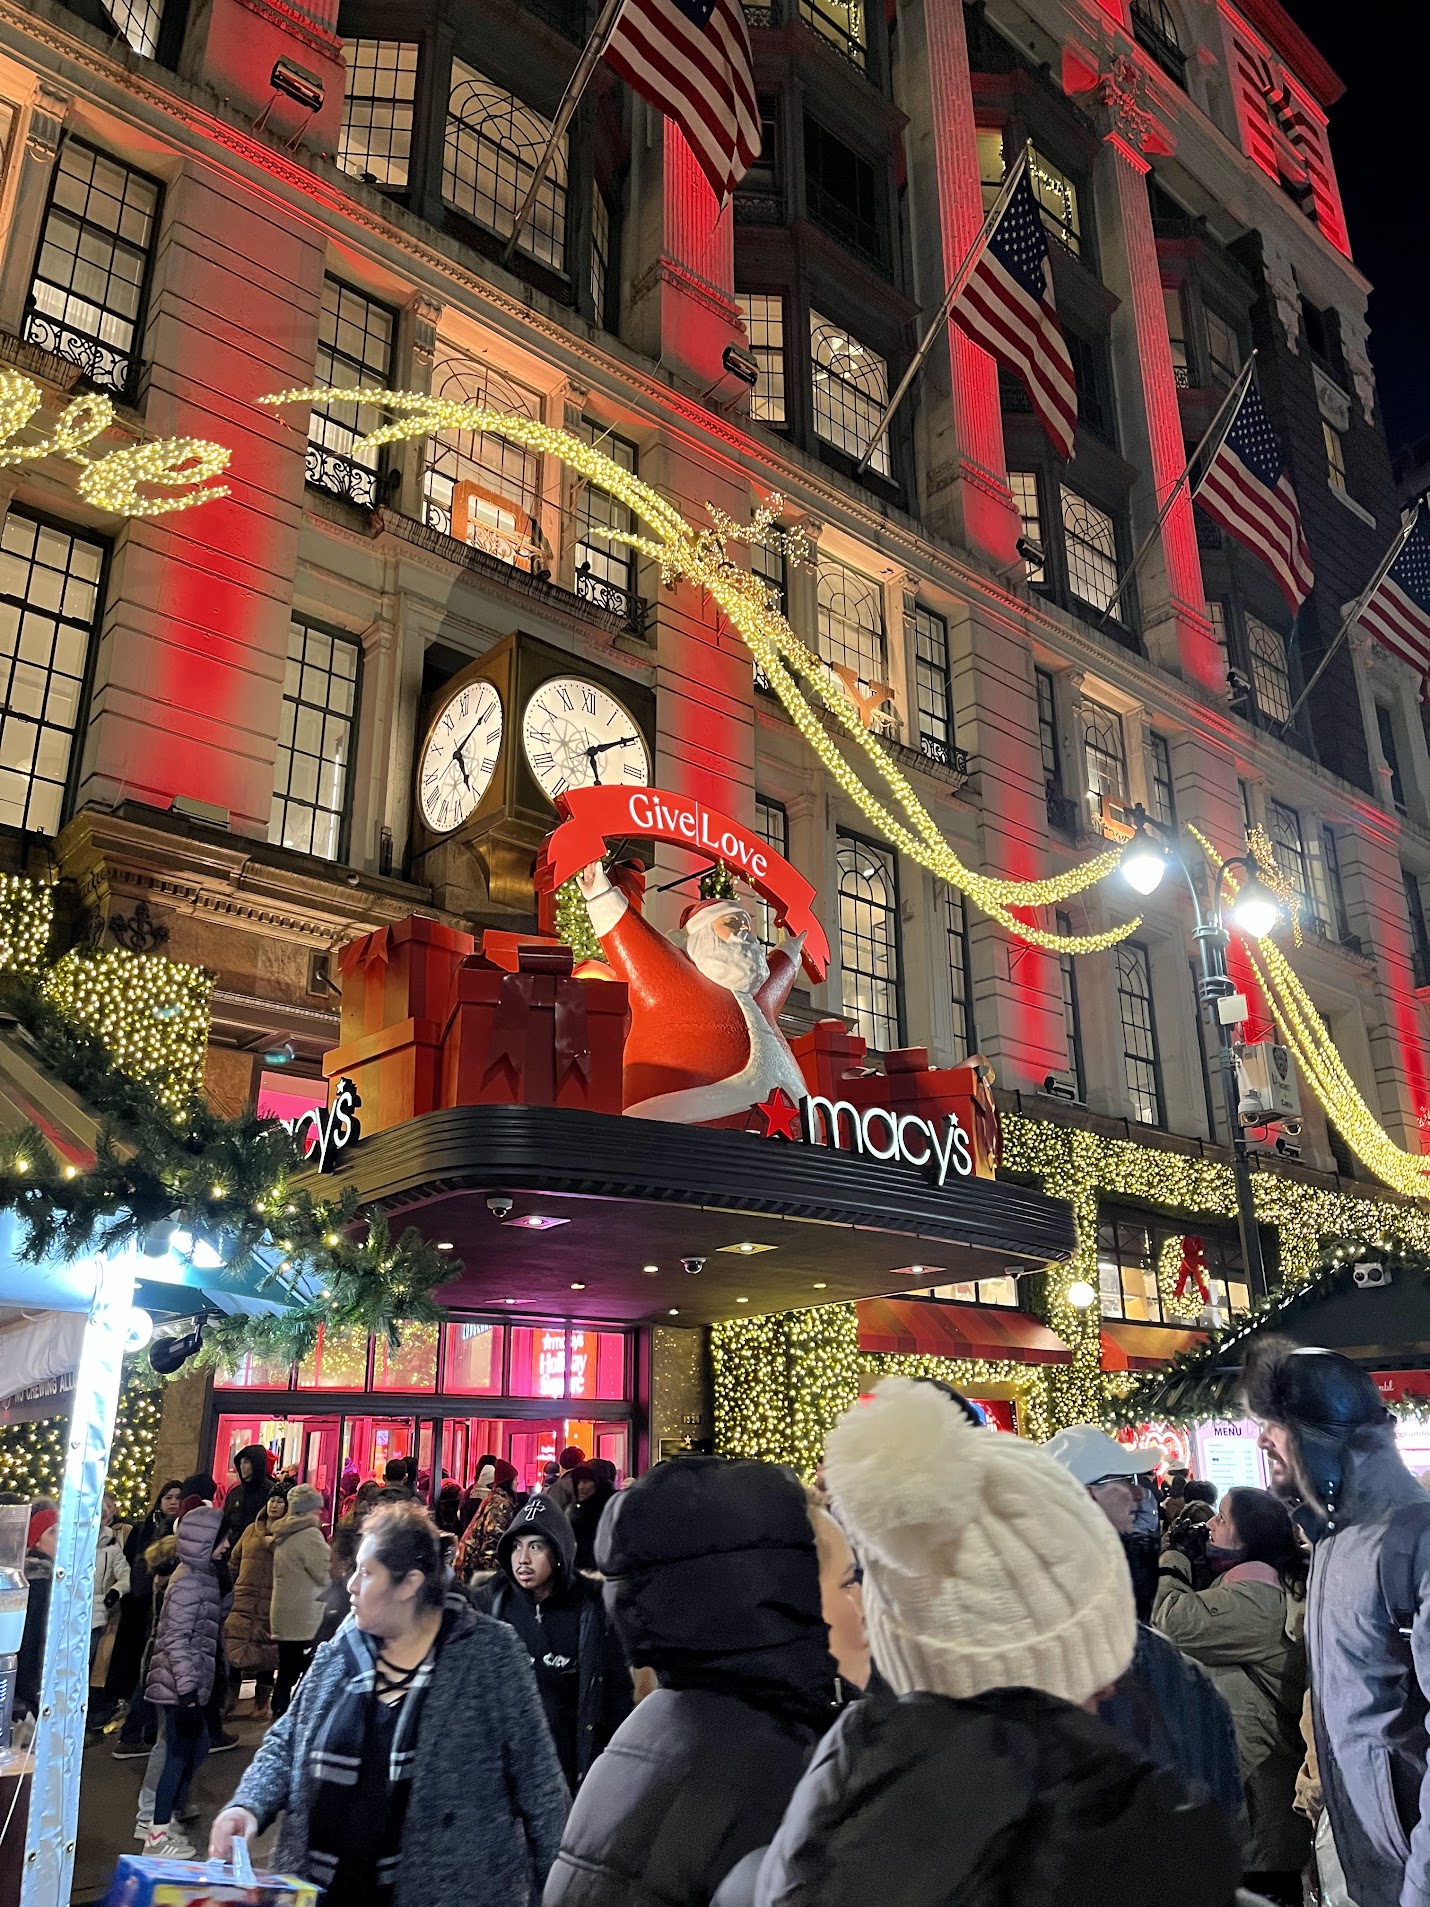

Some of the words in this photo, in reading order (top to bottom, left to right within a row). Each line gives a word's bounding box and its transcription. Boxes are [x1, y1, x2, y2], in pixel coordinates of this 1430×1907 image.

[537, 699, 558, 723] X
[581, 689, 596, 716] XII
[623, 763, 642, 780] III
[628, 793, 697, 837] Give
[701, 812, 768, 877] Love
[277, 1078, 353, 1174] cy's
[805, 1094, 973, 1187] macy's
[540, 1350, 588, 1377] Holiay
[1214, 1427, 1242, 1437] MENU
